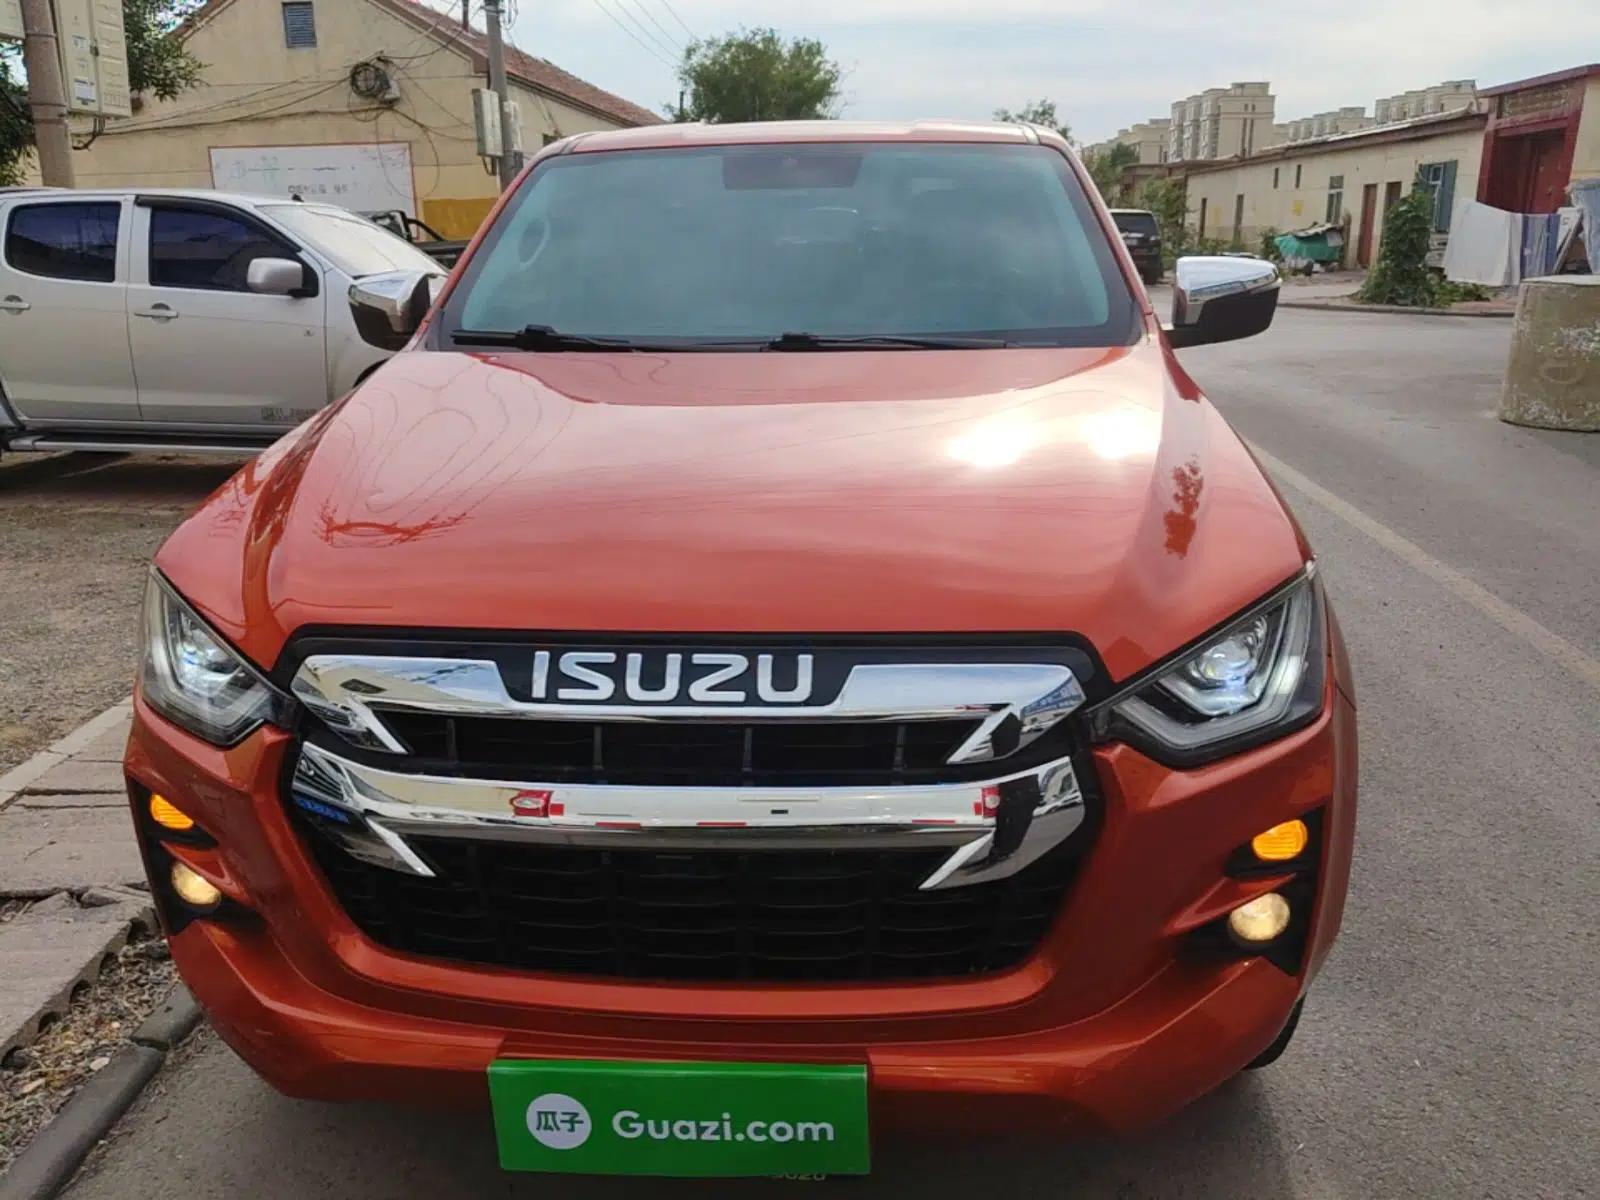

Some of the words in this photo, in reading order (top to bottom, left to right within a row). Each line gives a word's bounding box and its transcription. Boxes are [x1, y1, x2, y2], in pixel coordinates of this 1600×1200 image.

[531, 650, 814, 703] ISUZU
[536, 1110, 584, 1133] 瓜子
[612, 1111, 834, 1142] Guazi.com
